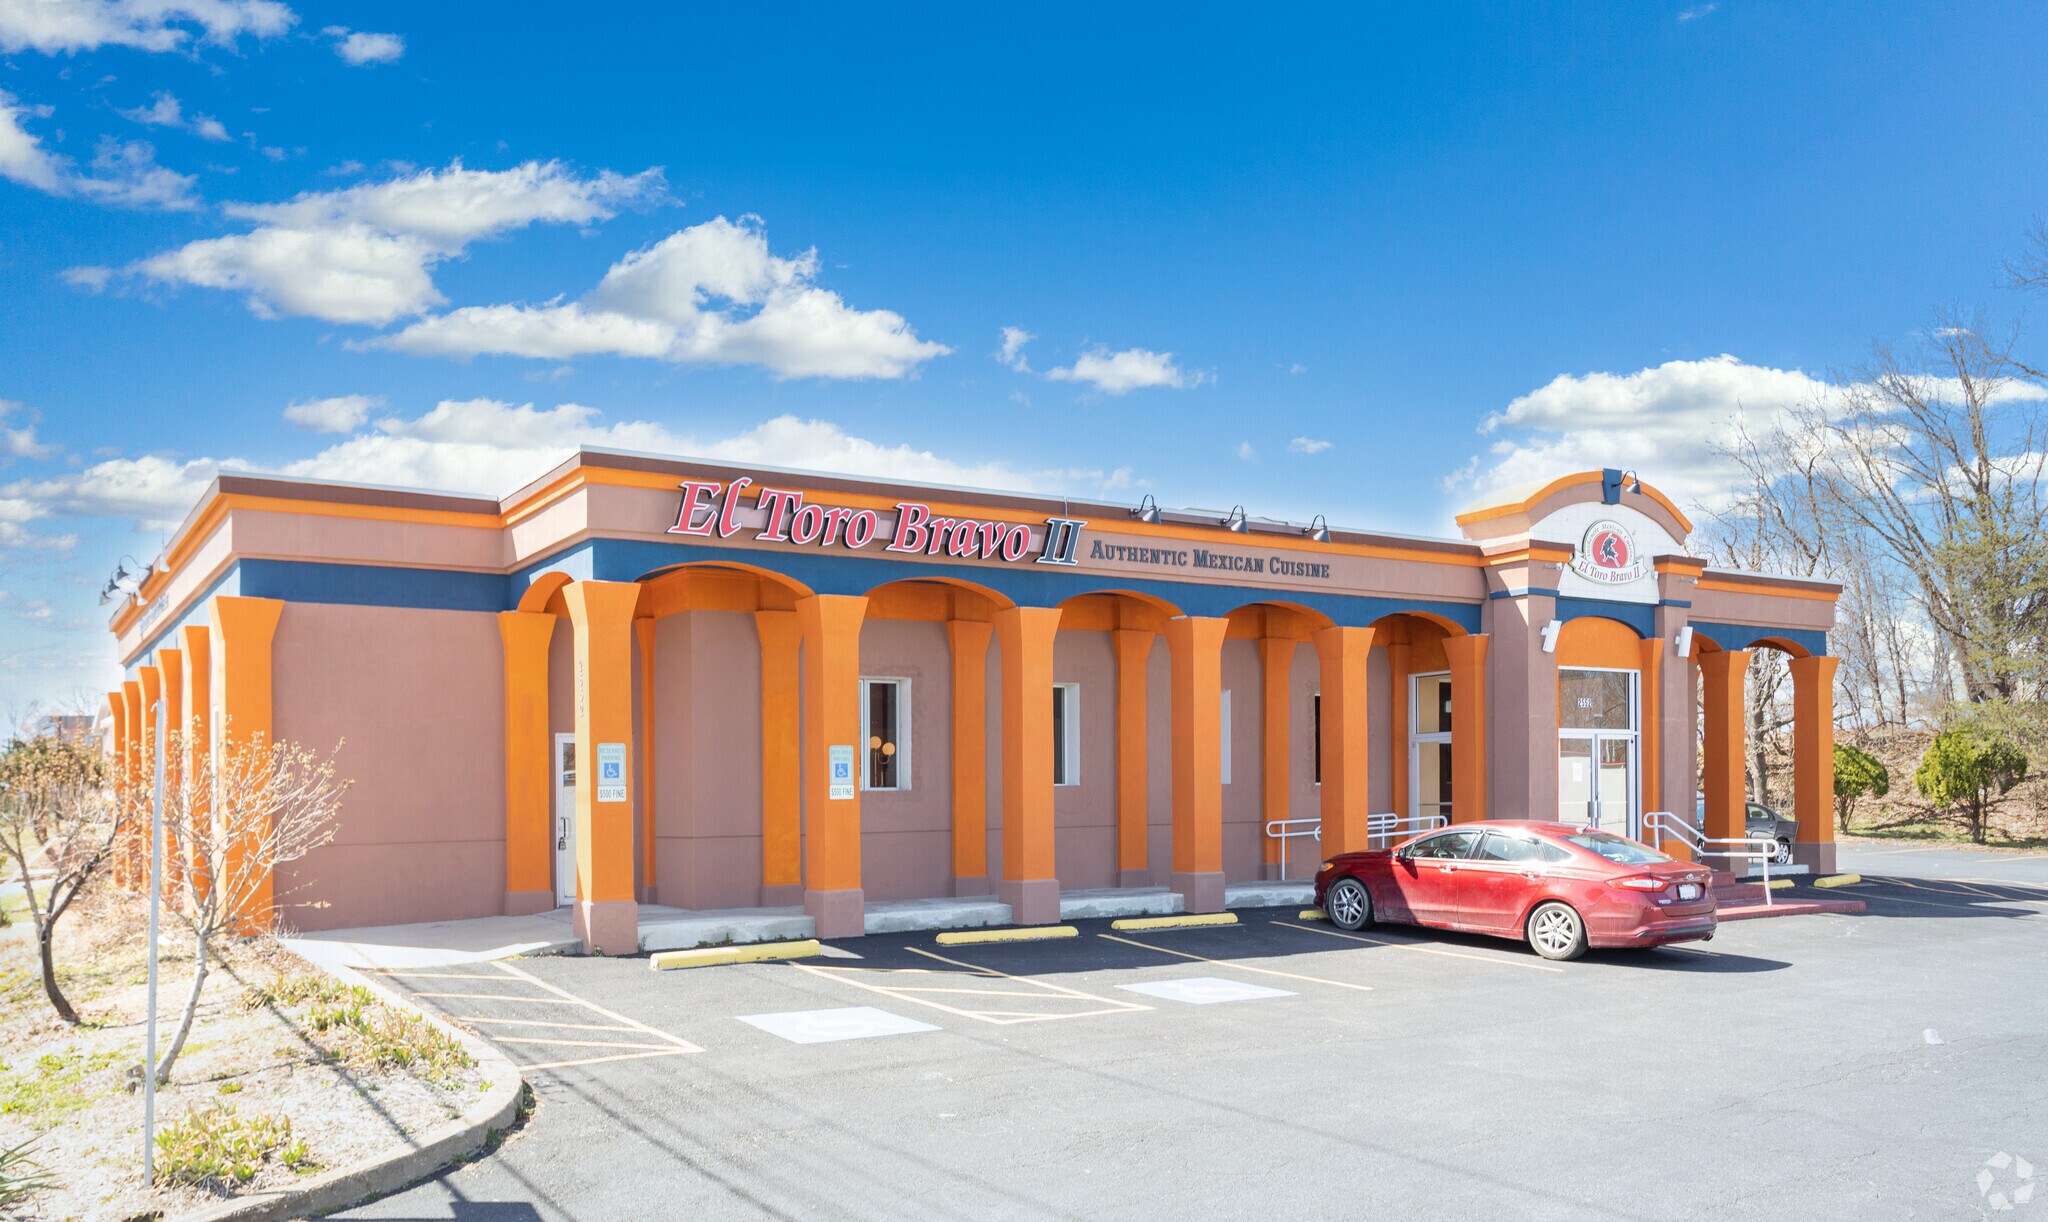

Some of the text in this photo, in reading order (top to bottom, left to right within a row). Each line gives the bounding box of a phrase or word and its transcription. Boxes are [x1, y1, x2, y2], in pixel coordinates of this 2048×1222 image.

[667, 476, 1088, 566] El Toro Bravo II
[1090, 539, 1330, 578] AUTHENTIC MEXICAN CUISINE
[1579, 561, 1588, 573] El
[1590, 566, 1608, 581] Toro
[1610, 571, 1632, 582] Bravo
[600, 789, 624, 798] $500 FINE
[843, 787, 853, 796] FINE
